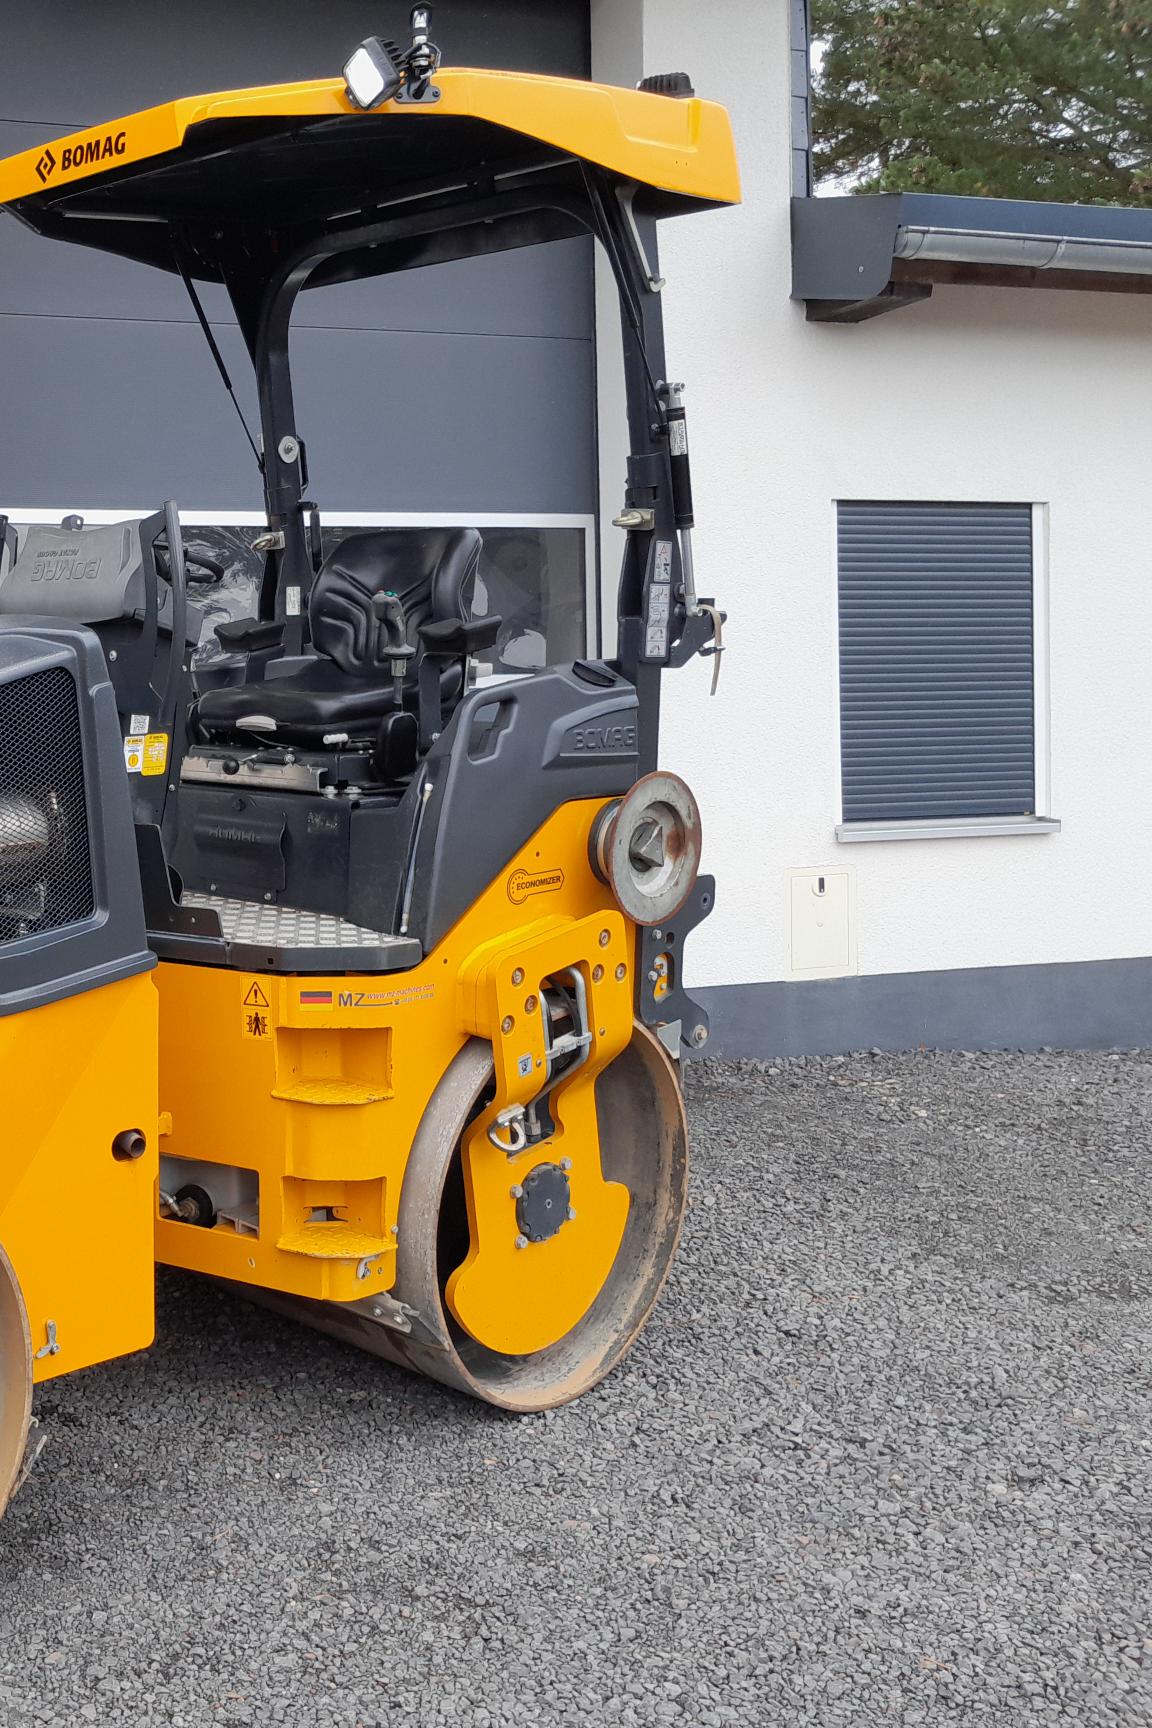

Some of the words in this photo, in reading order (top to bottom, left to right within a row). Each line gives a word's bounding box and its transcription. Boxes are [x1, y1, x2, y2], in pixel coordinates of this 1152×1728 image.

[61, 131, 126, 171] BOMAG
[32, 557, 102, 582] BOMAG
[573, 726, 636, 750] BOMAG
[516, 875, 561, 891] ECONOMIZER
[338, 991, 366, 1008] MZ
